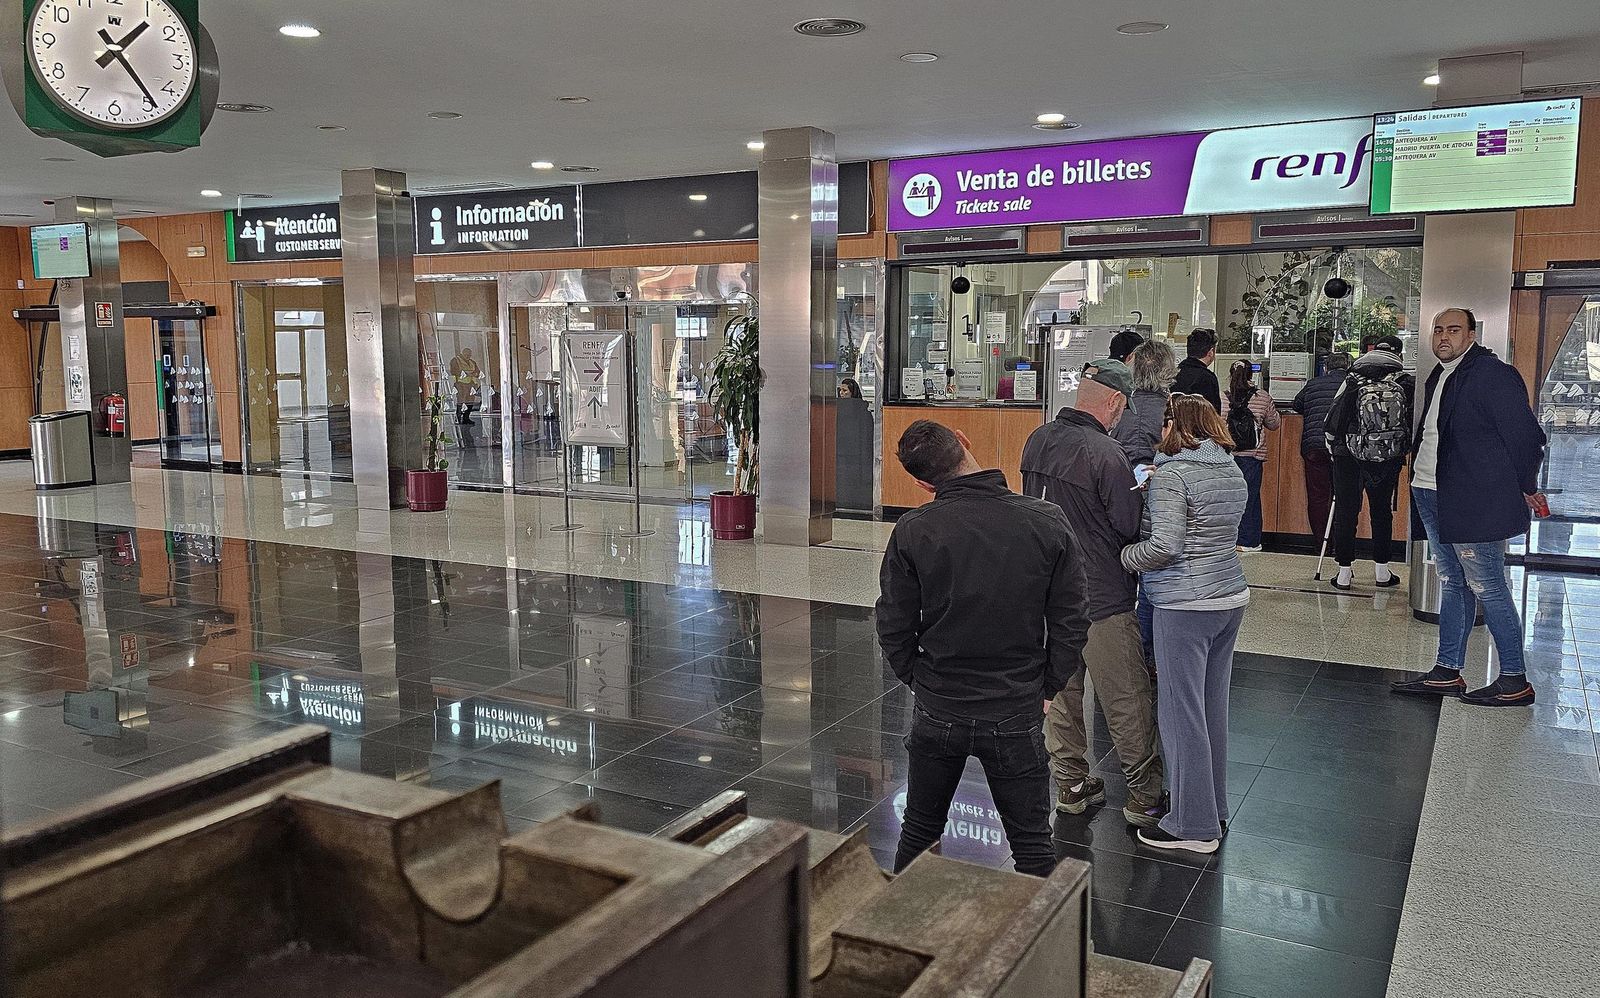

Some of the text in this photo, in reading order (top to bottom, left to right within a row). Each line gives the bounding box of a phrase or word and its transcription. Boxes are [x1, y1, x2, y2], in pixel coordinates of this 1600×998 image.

[54, 5, 70, 23] 10
[42, 33, 56, 49] 9
[163, 26, 176, 42] 2
[172, 53, 184, 70] 3
[53, 62, 65, 79] 8
[77, 86, 90, 101] 7
[161, 80, 175, 96] 4
[108, 100, 121, 116] 6
[1398, 111, 1467, 122] Salidas DEPARTURES
[1395, 136, 1428, 144] ANTEQUERA
[1394, 153, 1427, 161] ANTEQUERA
[956, 158, 1152, 192] Venta de billetes
[456, 198, 564, 226] Información
[955, 195, 1033, 215] Tickets sale
[274, 212, 337, 236] Atención
[457, 228, 529, 244] INFORMATION
[275, 239, 319, 252] CUSTOMER
